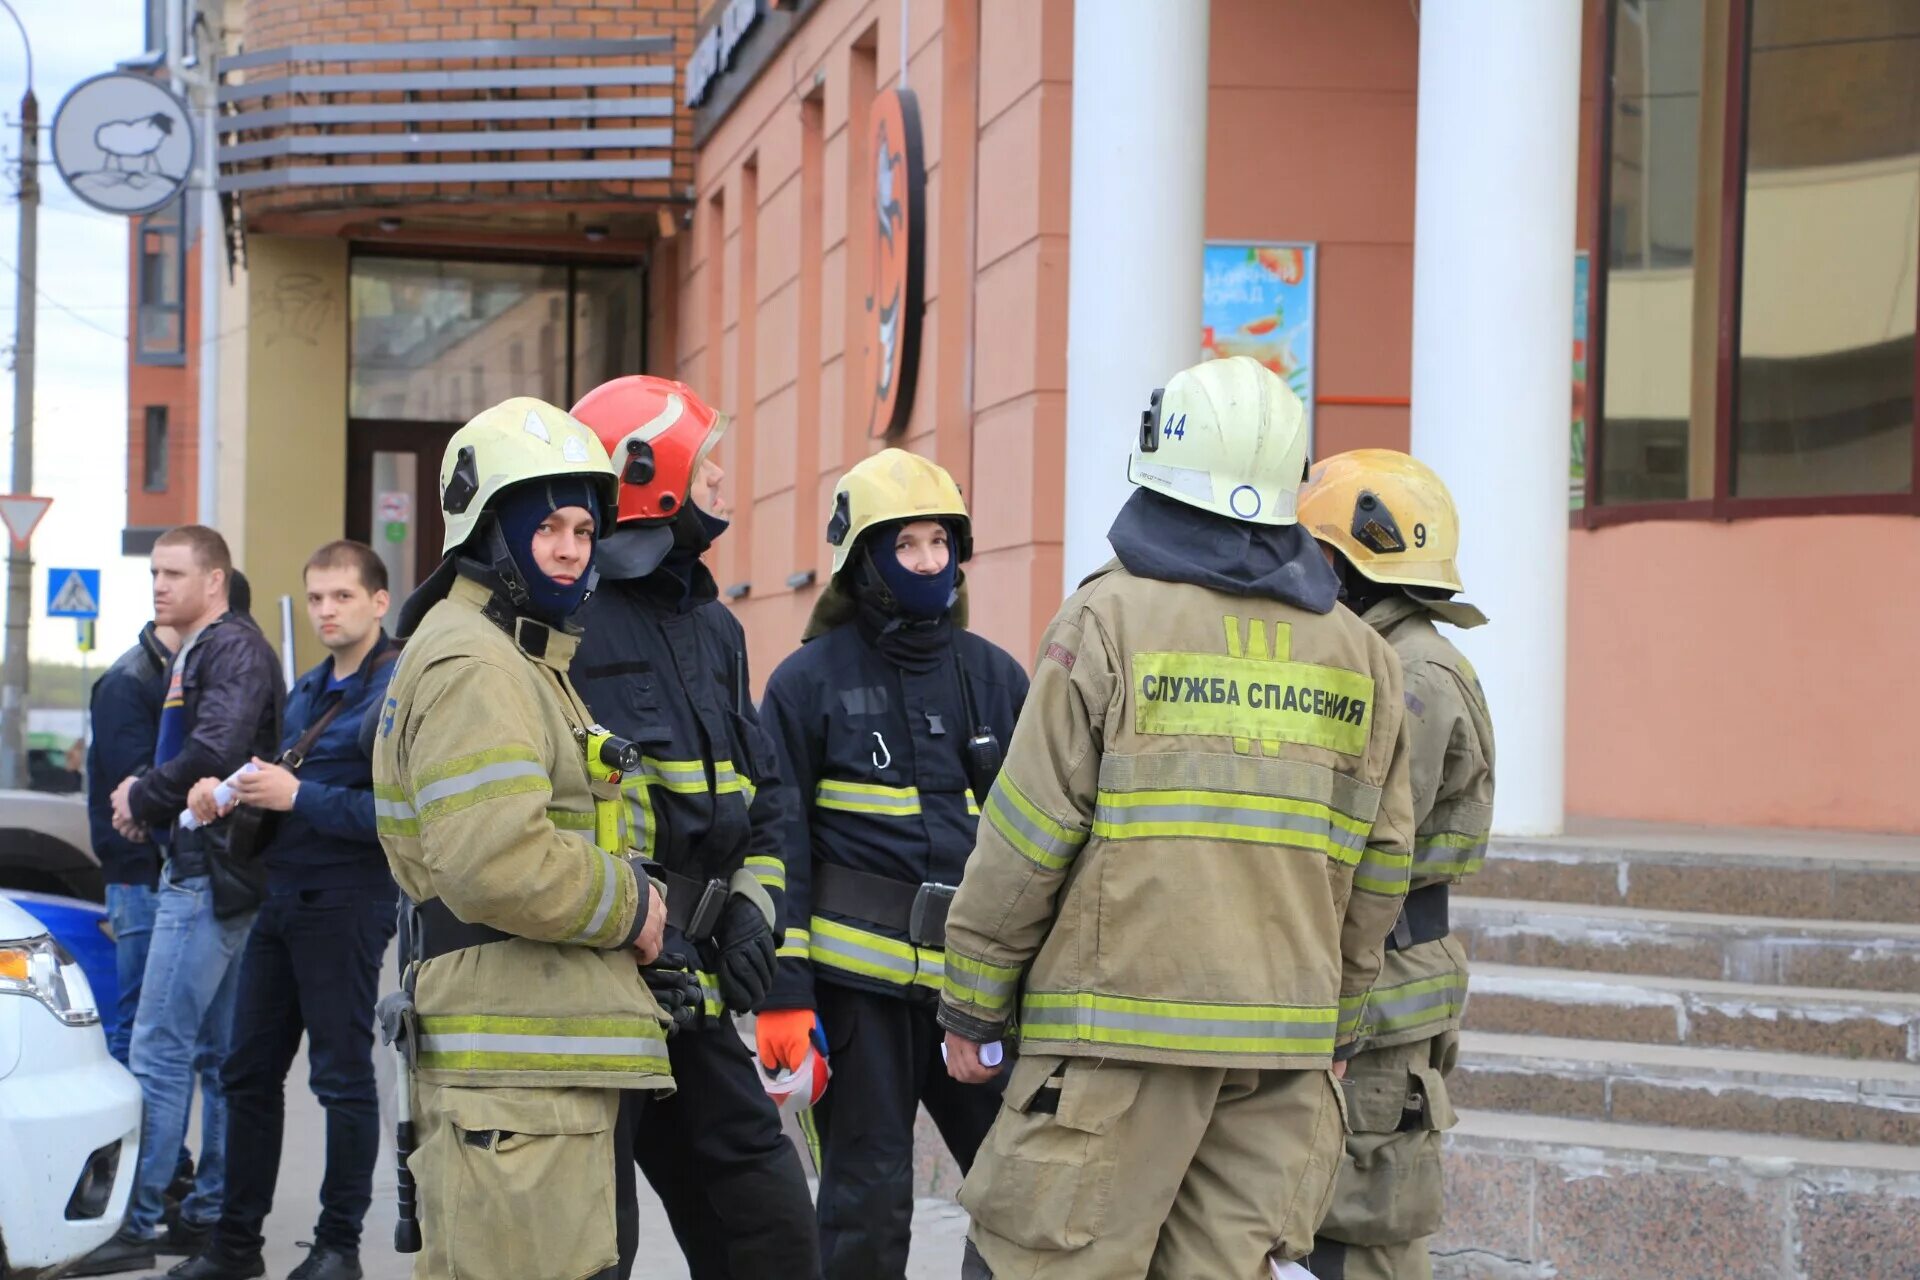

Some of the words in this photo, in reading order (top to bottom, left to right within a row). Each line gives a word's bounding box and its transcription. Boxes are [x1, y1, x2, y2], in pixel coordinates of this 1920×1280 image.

[1164, 412, 1187, 441] 44
[1142, 674, 1241, 706] СЛУЖБА
[1247, 682, 1366, 726] СПАСЕНИЯ
